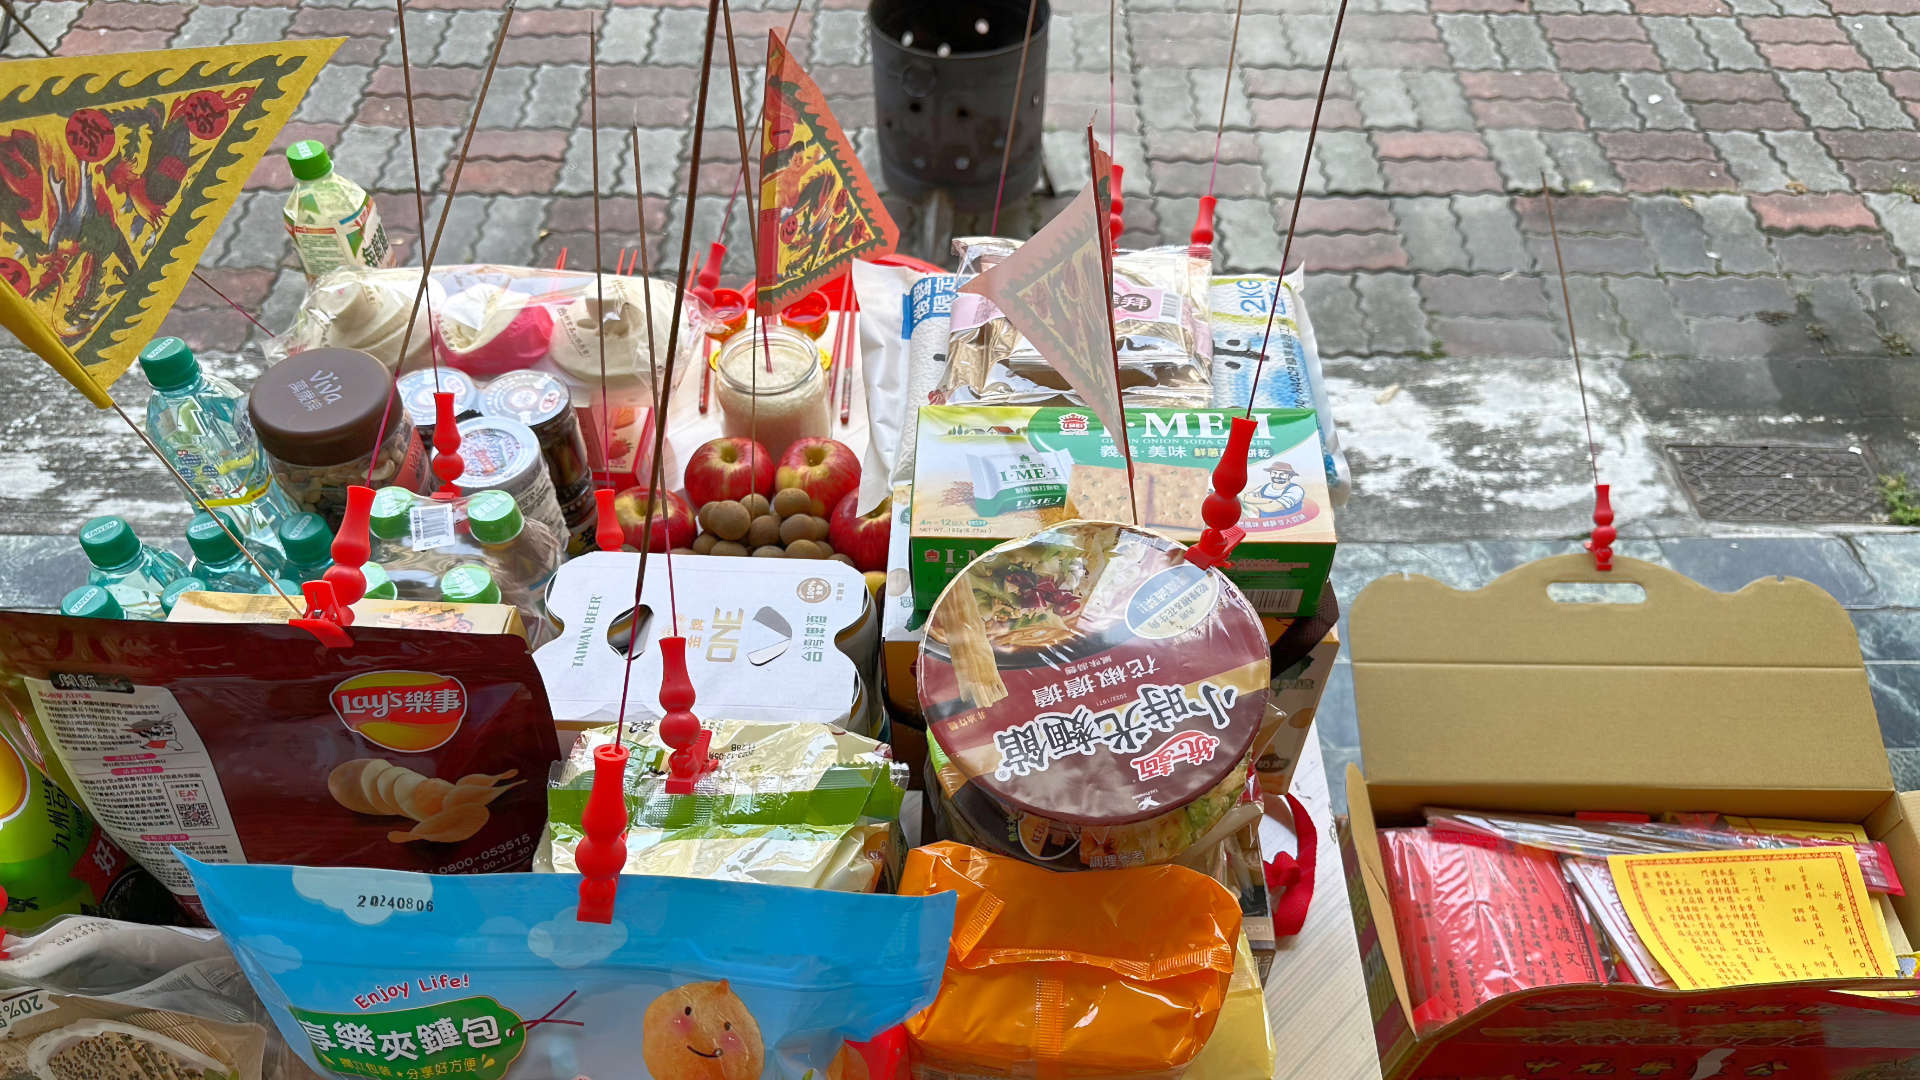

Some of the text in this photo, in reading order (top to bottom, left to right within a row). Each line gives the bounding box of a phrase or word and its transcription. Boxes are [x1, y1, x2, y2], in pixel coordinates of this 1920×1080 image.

[1240, 279, 1261, 316] 2KG
[310, 369, 344, 406] Viva
[1194, 447, 1271, 459] 鮮蔥餅乾
[571, 594, 602, 668] TAIWAN BEER
[704, 606, 744, 663] ONE
[801, 614, 828, 662] 台灣啤酒
[1032, 654, 1161, 708] 花椒擔擔
[341, 687, 463, 716] Lay's 樂事
[997, 686, 1237, 780] 小時光麵館
[1131, 730, 1220, 781] 統一麵
[439, 833, 531, 875] 0800-053515
[357, 895, 435, 912] 20240806
[3, 994, 43, 1020] 20%
[353, 973, 470, 1010] Enjoy Life!
[298, 1014, 502, 1062] 享樂夾鏈包
[406, 1057, 478, 1080] 分享好方便
